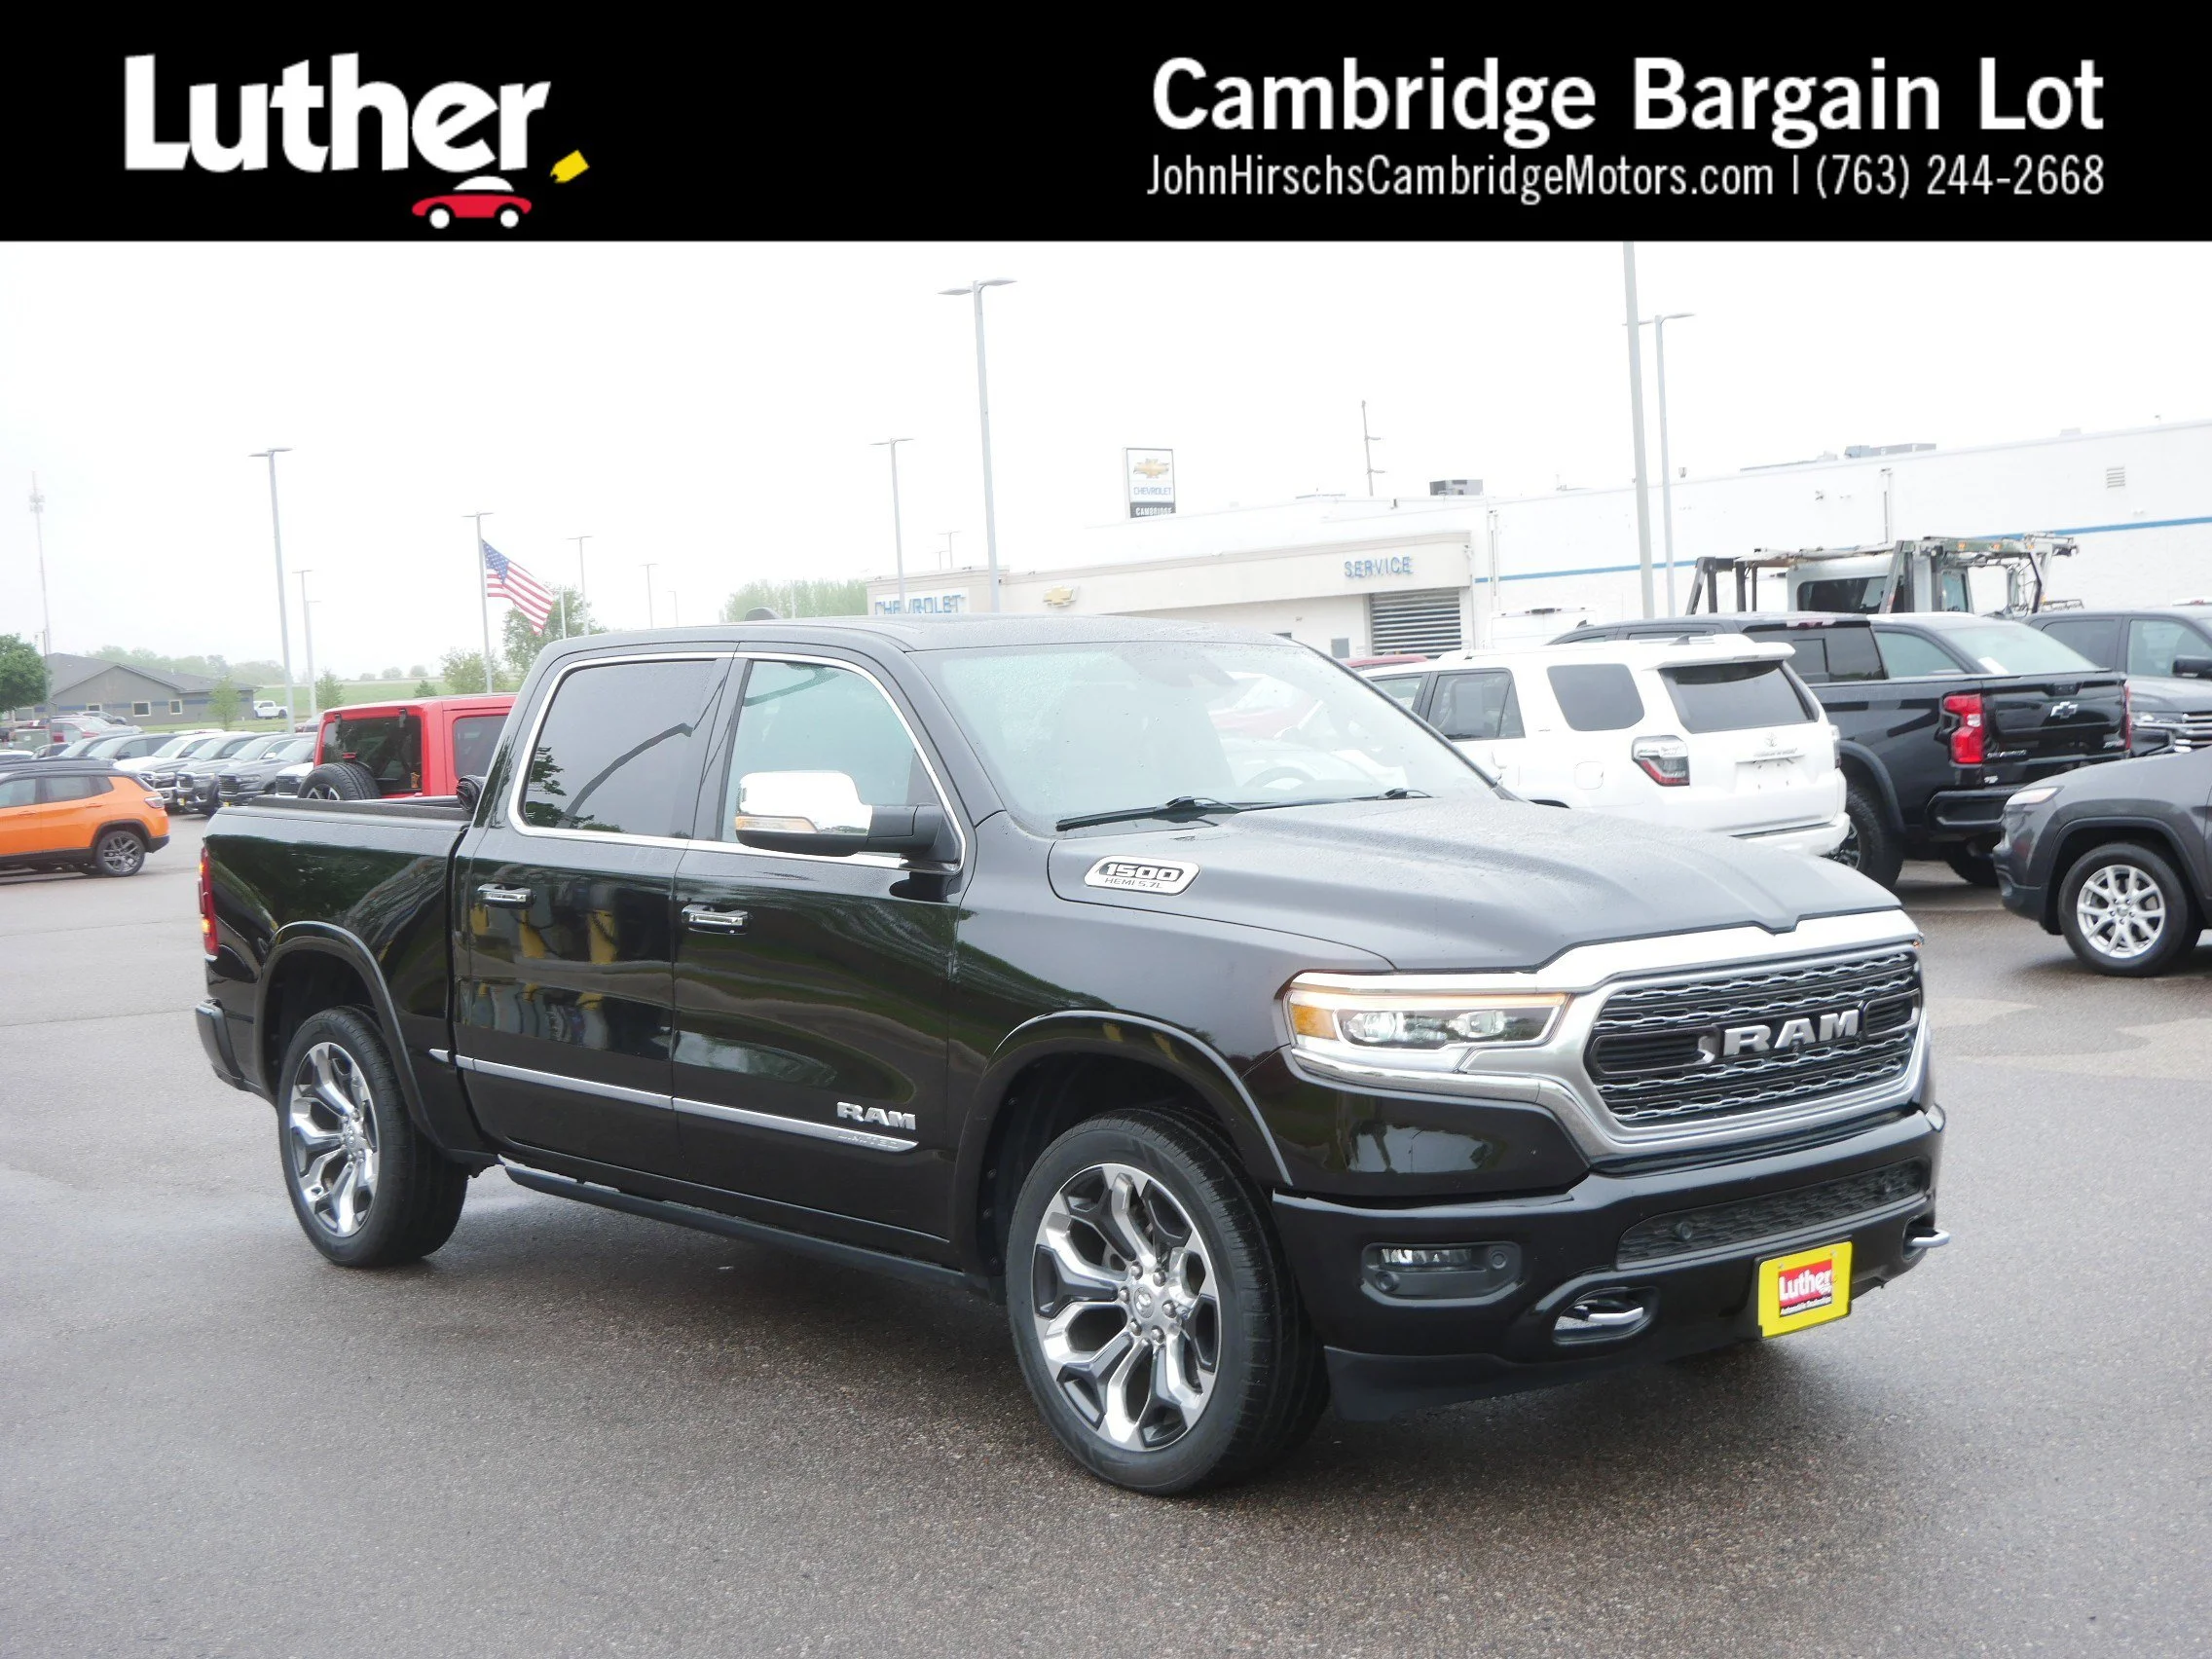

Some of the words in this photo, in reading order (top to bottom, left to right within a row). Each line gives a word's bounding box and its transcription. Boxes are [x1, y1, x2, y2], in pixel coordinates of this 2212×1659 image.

[1133, 487, 1172, 496] CHEVROLET
[1345, 556, 1412, 577] SERVICE
[1104, 877, 1136, 886] HEMI
[1137, 880, 1163, 889] 5.7L
[1106, 863, 1181, 882] 1500
[1723, 1009, 1860, 1056] RAM
[837, 1101, 916, 1130] RAM
[1779, 1270, 1832, 1302] Luther
